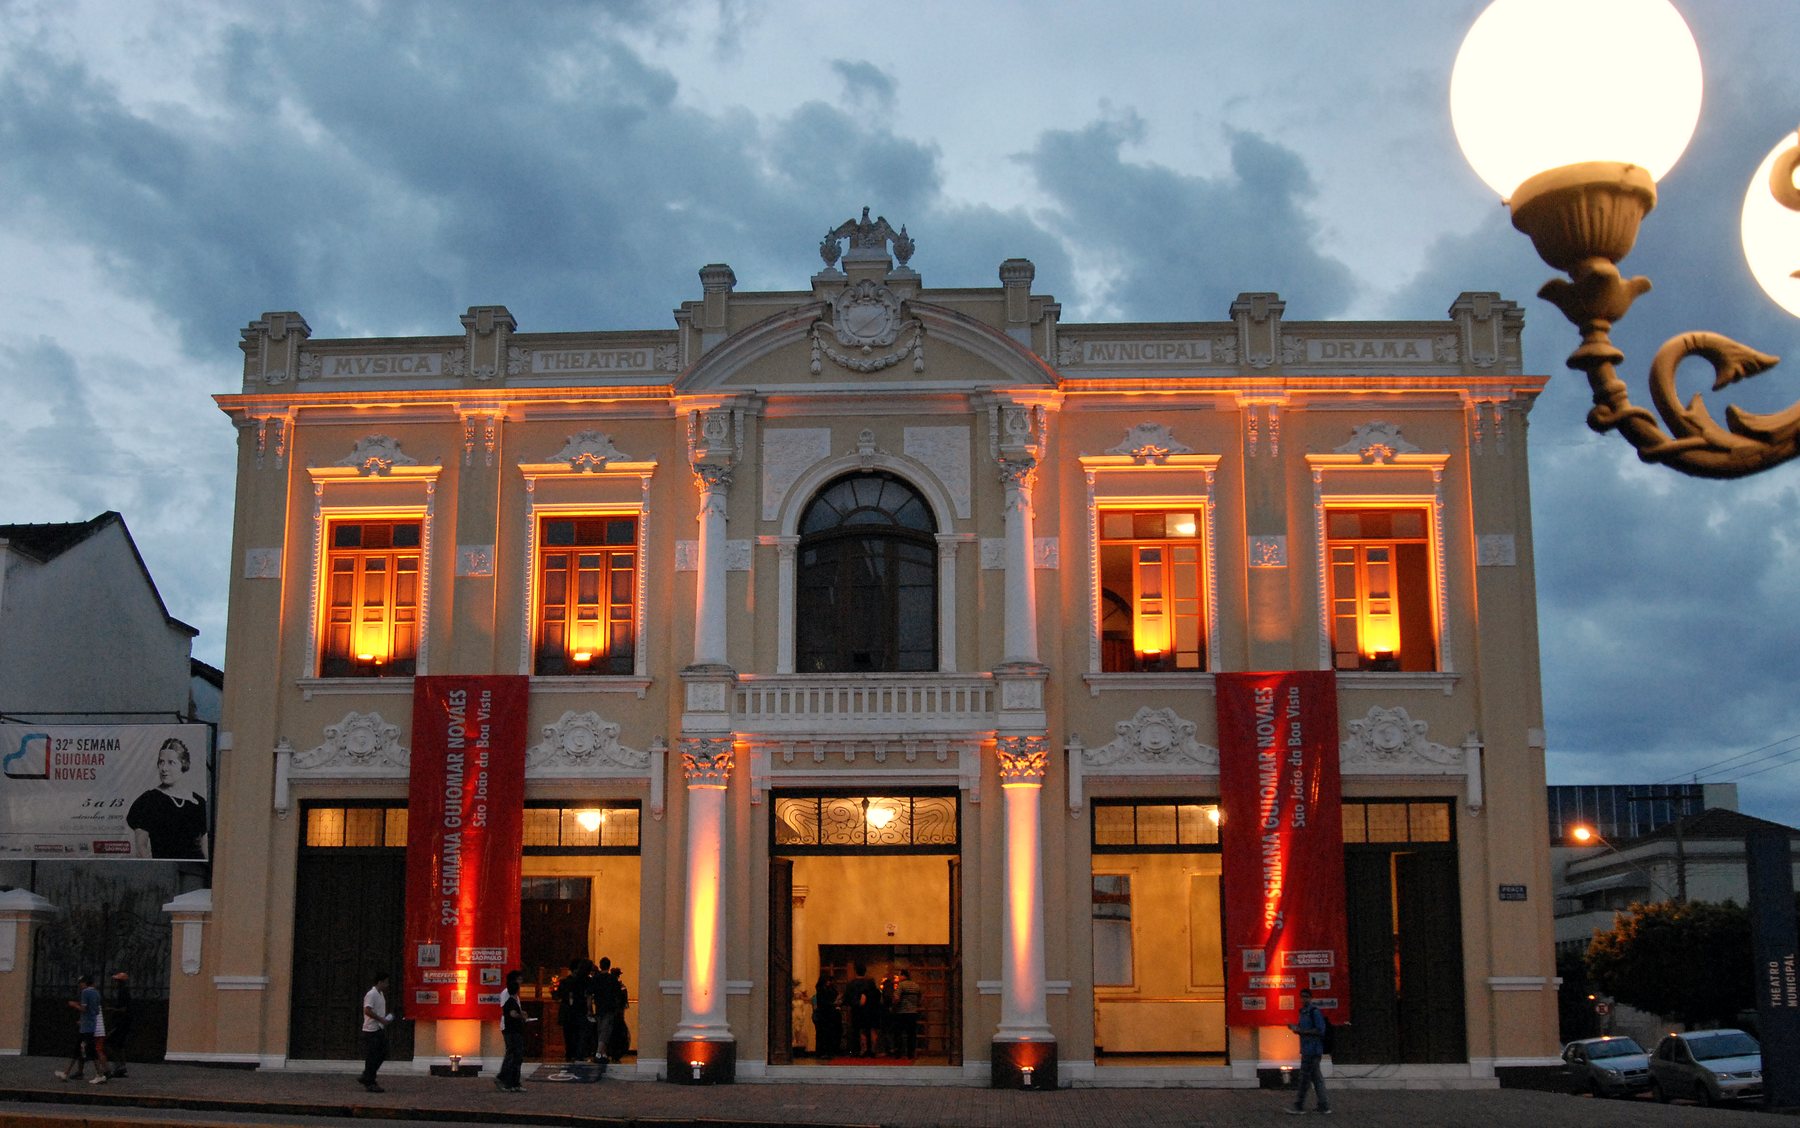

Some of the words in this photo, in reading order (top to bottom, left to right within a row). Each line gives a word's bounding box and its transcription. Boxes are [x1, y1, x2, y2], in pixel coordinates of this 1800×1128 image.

[540, 350, 646, 370] THEATRO
[1088, 343, 1208, 362] MVNICIPAL
[1320, 341, 1421, 360] DRAMA
[332, 355, 434, 376] MVSICA
[478, 690, 491, 721] Vista
[1287, 686, 1300, 719] Vista
[447, 690, 467, 749] NOVAES
[1255, 687, 1276, 748] NOVAES
[77, 739, 121, 751] SEMANA
[476, 725, 490, 748] Boa
[1288, 722, 1302, 746] Boa
[55, 753, 105, 766] GUIOMAR
[475, 752, 489, 768] da
[1288, 751, 1303, 767] da
[54, 768, 97, 780] NOVAES
[474, 771, 488, 800] João
[1290, 770, 1304, 800] João
[445, 753, 464, 828] GUIOMAR
[1258, 752, 1280, 829] GUIOMAR
[473, 804, 487, 827] São
[1291, 804, 1305, 828] São
[443, 832, 462, 895] SEMANA
[1262, 832, 1282, 898] SEMANA
[1770, 961, 1782, 1007] THEATRO
[1784, 953, 1798, 1007] MUNICIPAL
